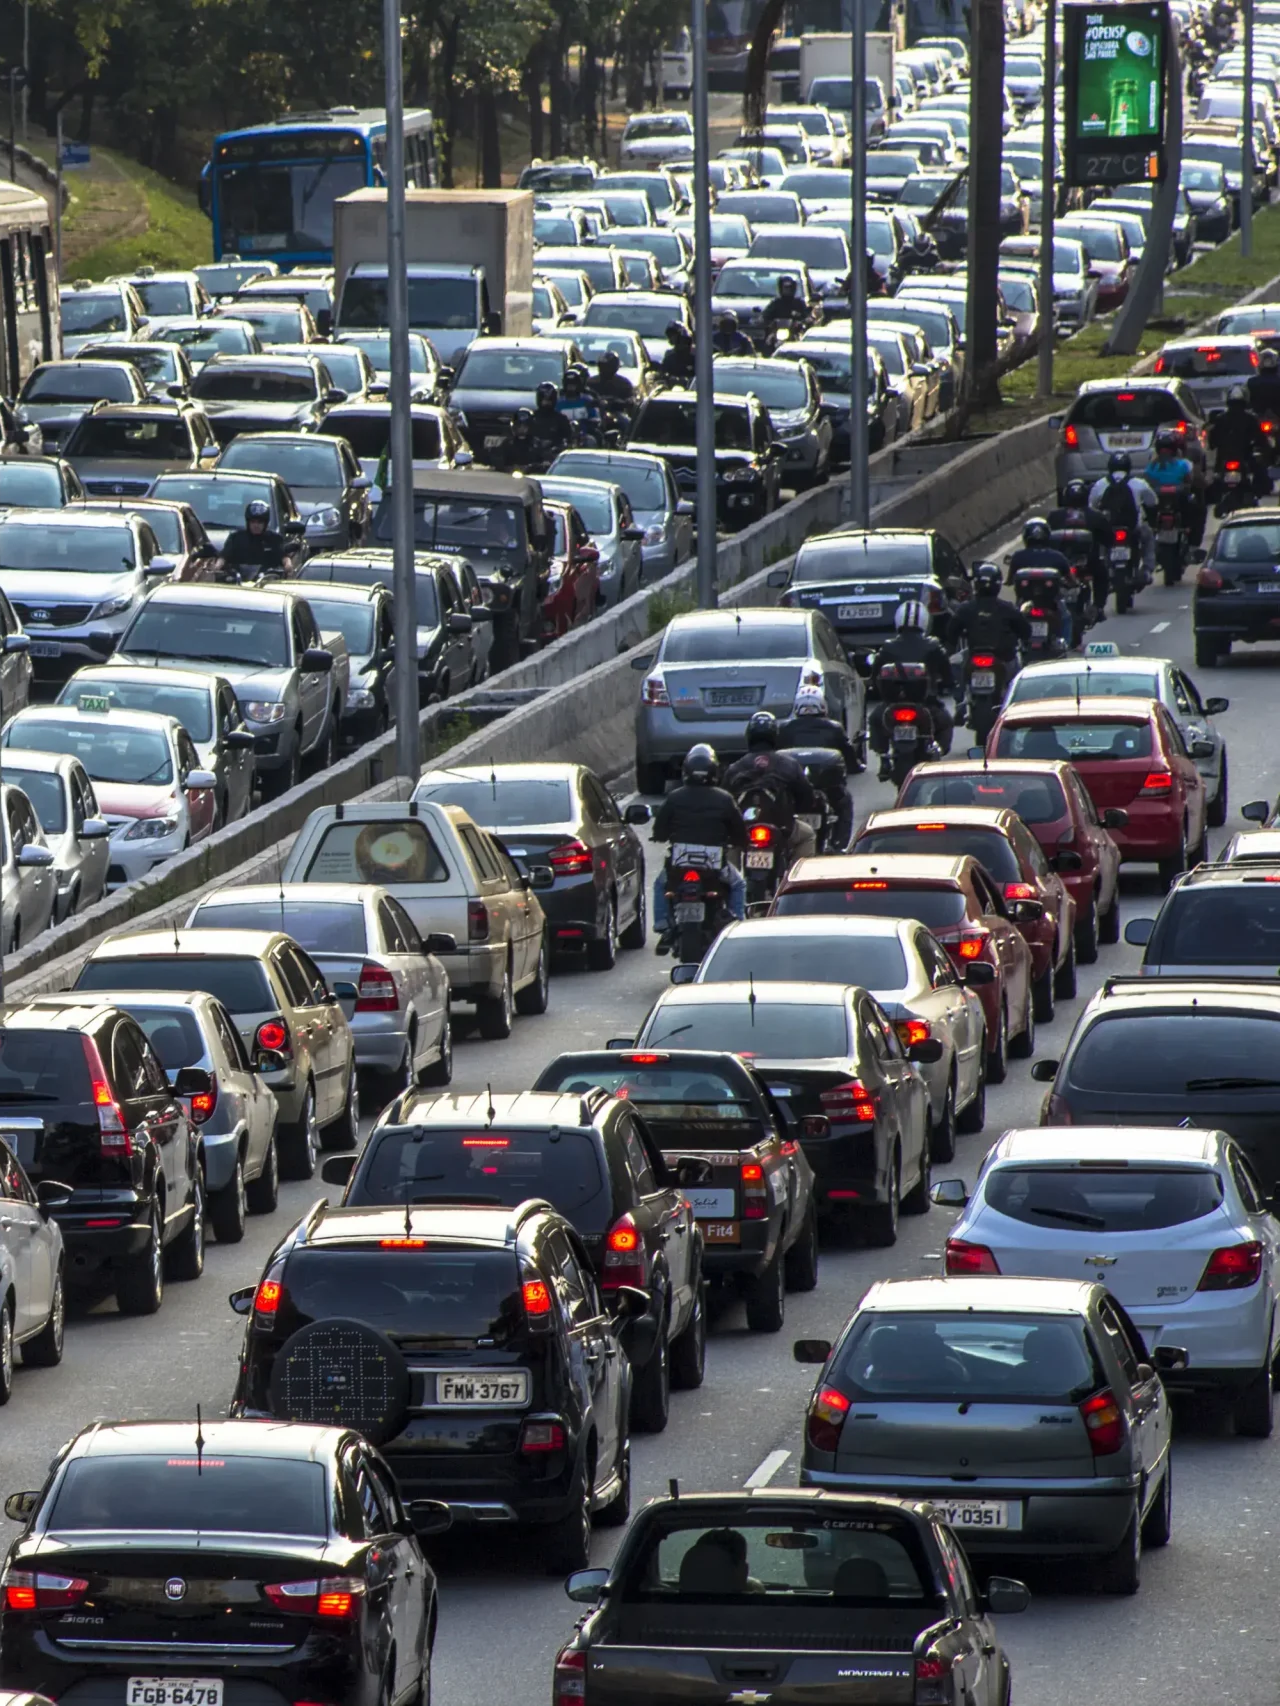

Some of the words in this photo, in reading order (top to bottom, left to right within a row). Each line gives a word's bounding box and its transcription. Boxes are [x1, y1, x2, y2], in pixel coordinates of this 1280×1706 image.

[1089, 644, 1113, 654] TAXI
[81, 698, 107, 710] TAXI
[707, 1225, 734, 1237] Fit4
[169, 1584, 182, 1595] FIAT
[838, 1669, 893, 1677] MONTANA
